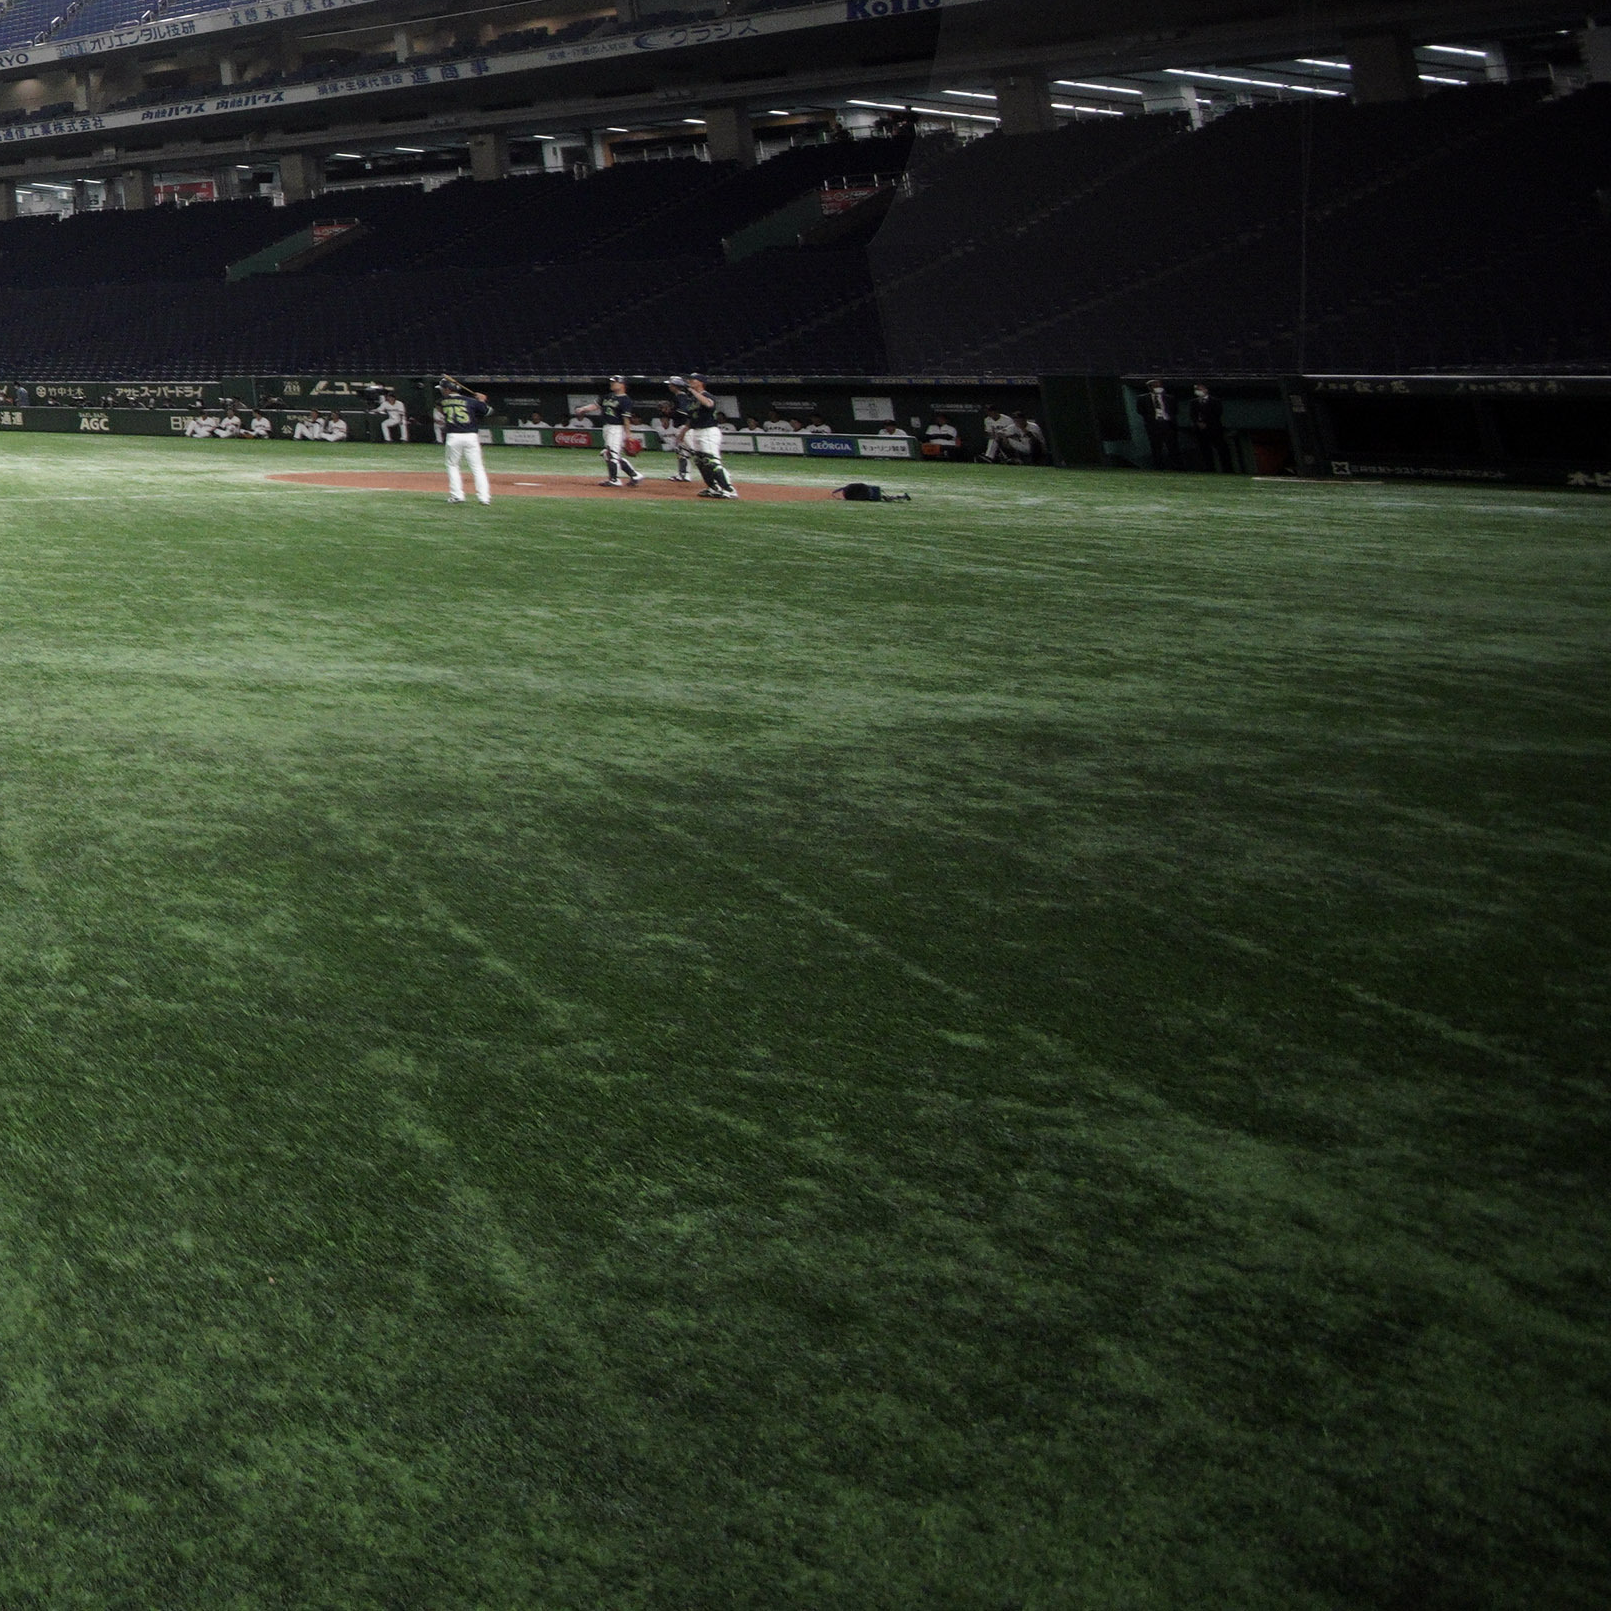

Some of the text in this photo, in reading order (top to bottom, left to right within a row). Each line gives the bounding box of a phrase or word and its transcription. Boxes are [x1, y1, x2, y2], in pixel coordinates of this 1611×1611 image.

[89, 20, 195, 52] オリエンタル技研
[443, 406, 471, 424] 75
[80, 417, 110, 431] AGC
[554, 431, 589, 445] Coca-Cola
[810, 439, 852, 452] GEORGIA
